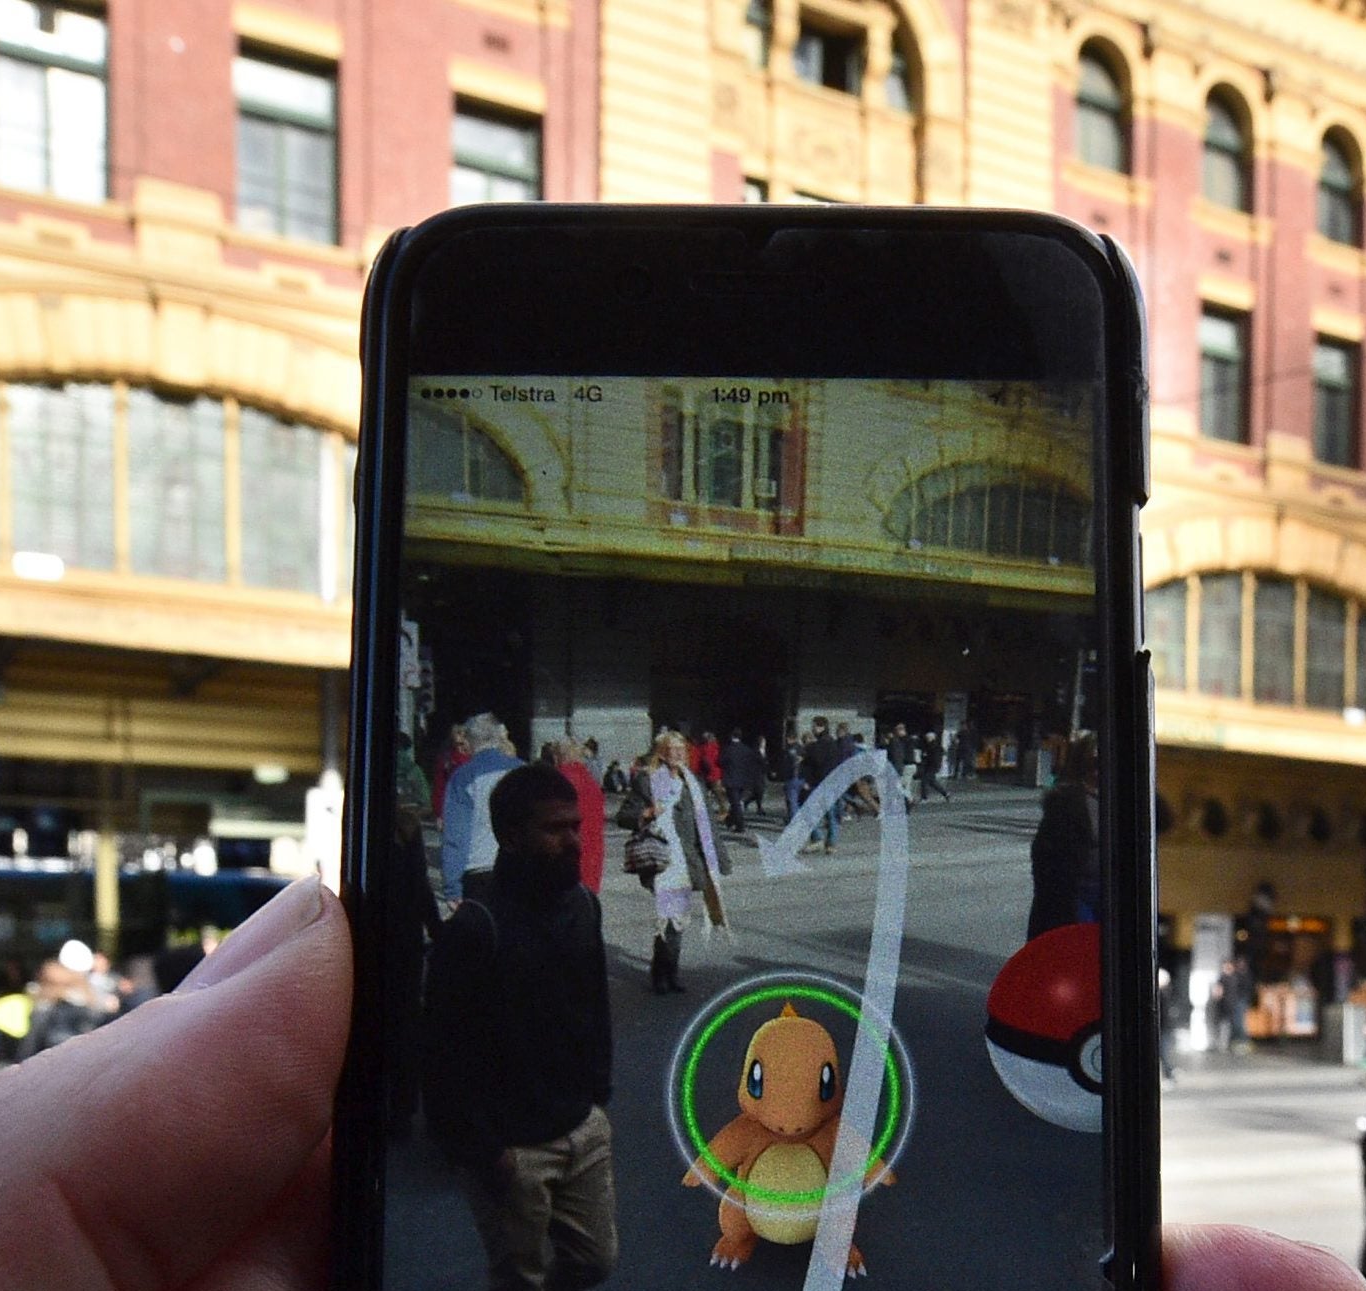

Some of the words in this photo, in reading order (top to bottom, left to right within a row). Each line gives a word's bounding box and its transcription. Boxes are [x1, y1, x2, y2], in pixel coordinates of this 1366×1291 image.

[489, 385, 555, 402] Telstra
[574, 386, 603, 402] 4G
[712, 387, 751, 404] 1:49
[757, 390, 790, 407] pm
